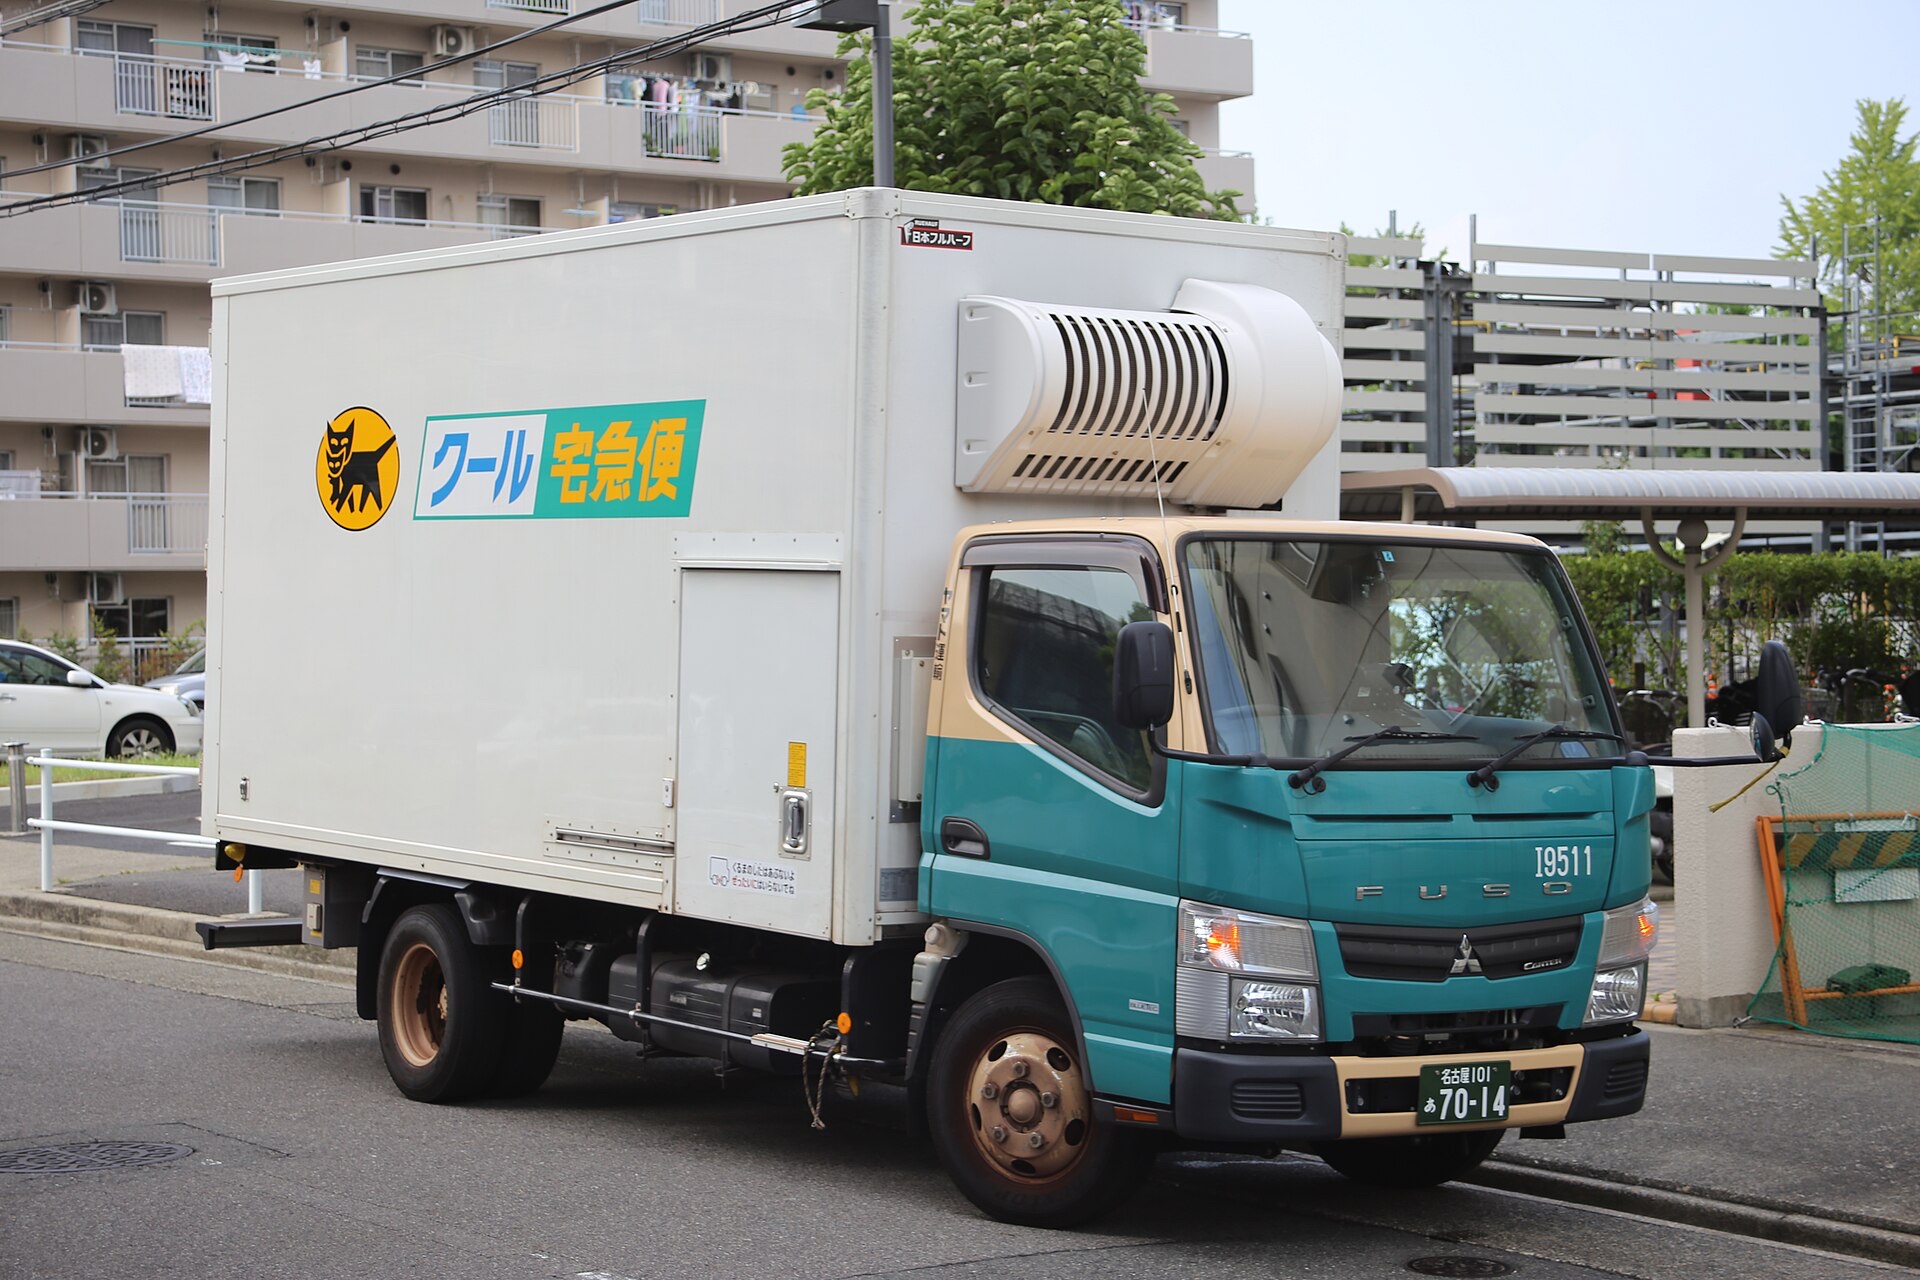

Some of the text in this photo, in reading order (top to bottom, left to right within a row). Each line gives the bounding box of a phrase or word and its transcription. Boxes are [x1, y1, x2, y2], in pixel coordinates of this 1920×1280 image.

[912, 231, 971, 246] 日本フルハーフ
[430, 417, 688, 508] クール 宅急便
[1535, 845, 1592, 878] I9511
[1356, 881, 1573, 901] FUSO
[1423, 1085, 1506, 1121] あ 70-14
